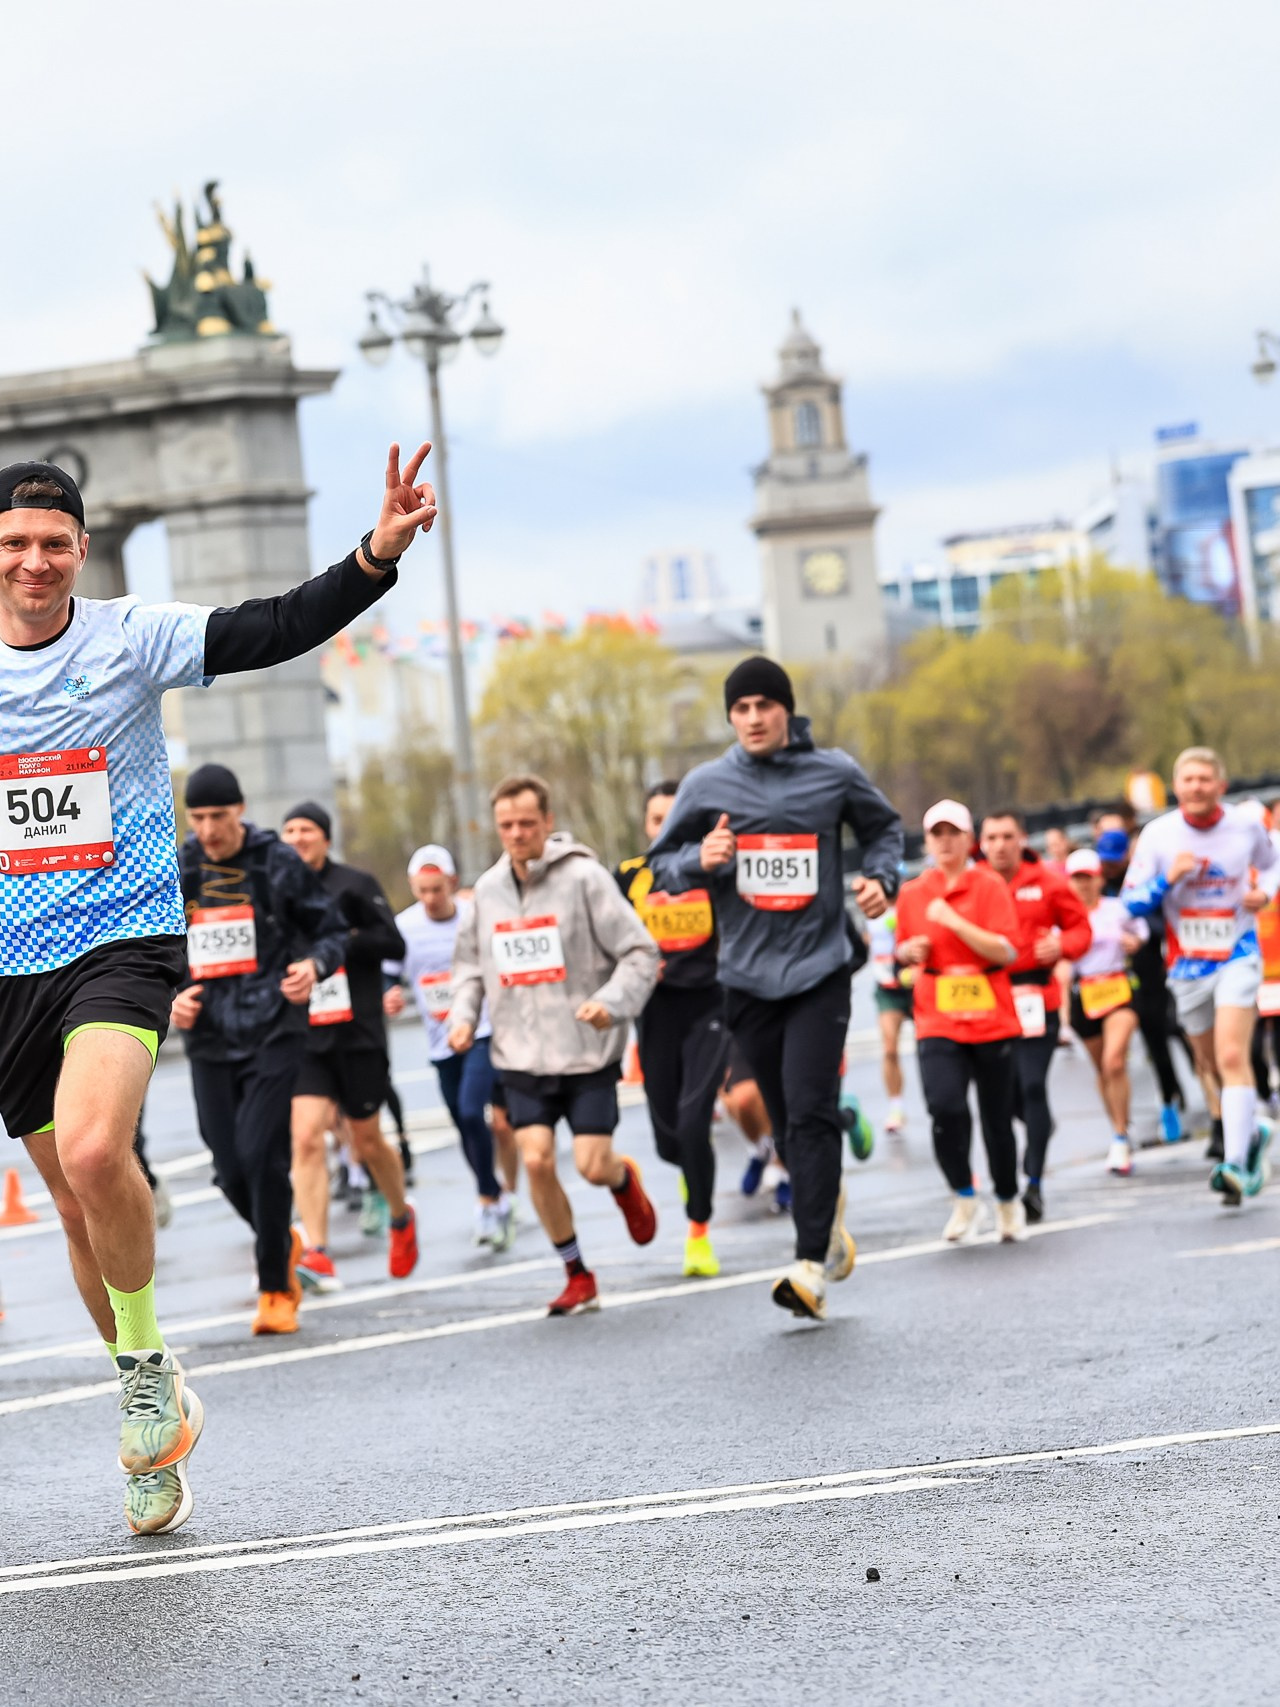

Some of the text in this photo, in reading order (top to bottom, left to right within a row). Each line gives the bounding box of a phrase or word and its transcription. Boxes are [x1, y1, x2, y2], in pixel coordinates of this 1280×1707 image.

[6, 785, 81, 825] 504
[23, 824, 67, 839] ДАНИЛ
[743, 858, 812, 879] 10851
[190, 926, 252, 950] 12555
[504, 936, 550, 957] 1530
